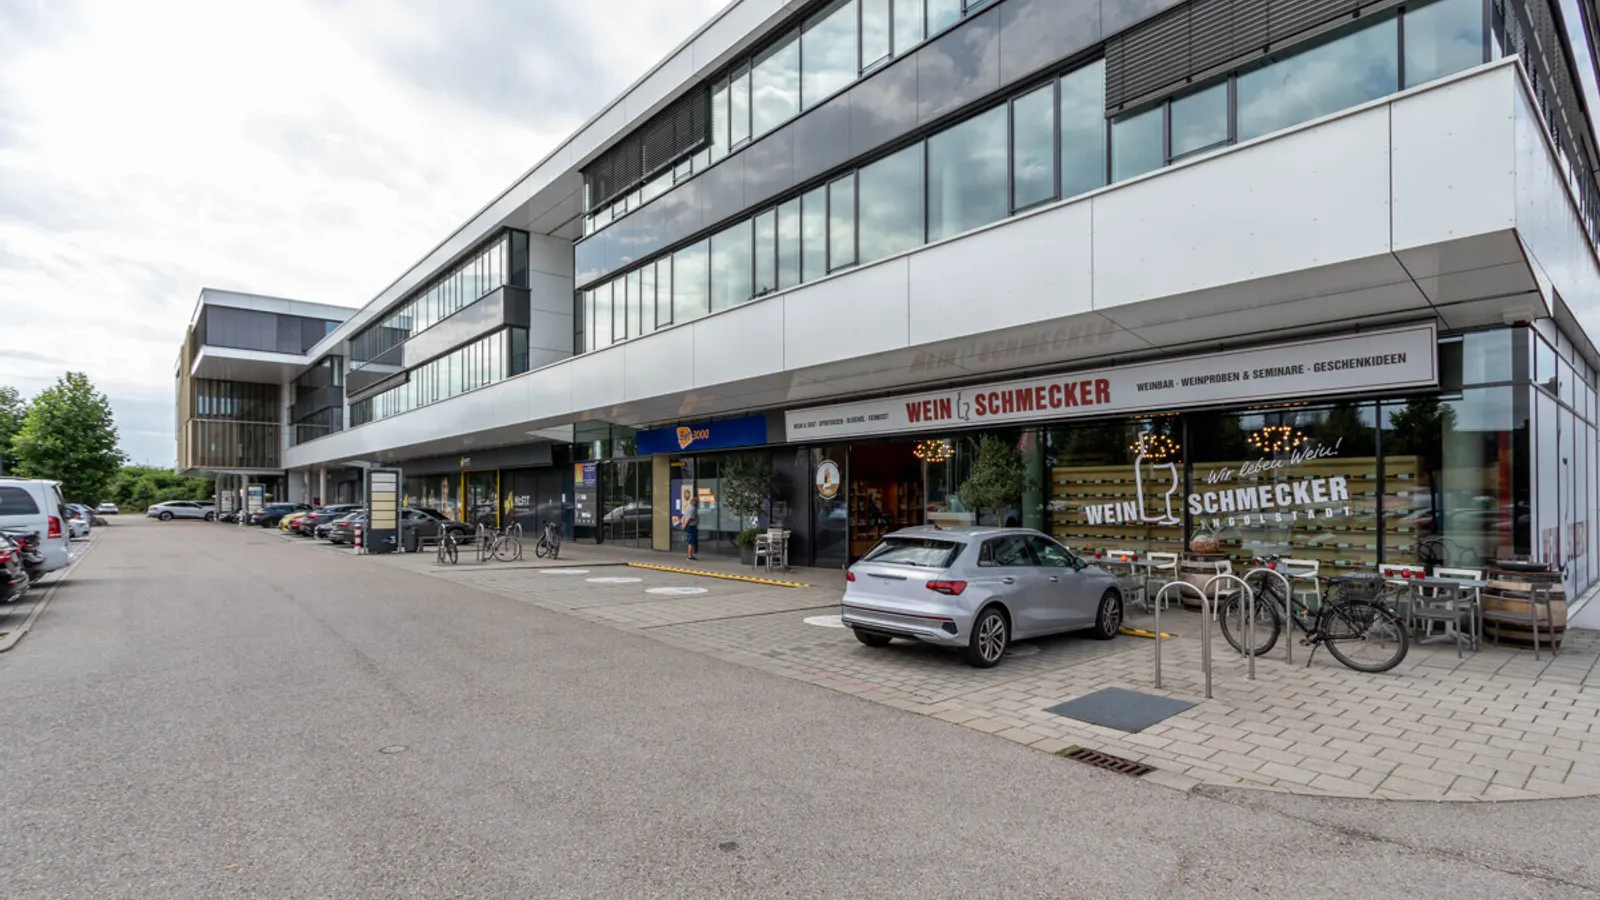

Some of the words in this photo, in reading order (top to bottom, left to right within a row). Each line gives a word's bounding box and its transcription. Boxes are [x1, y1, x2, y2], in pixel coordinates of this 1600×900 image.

[1137, 379, 1174, 392] WEINBAR
[1181, 371, 1240, 387] WEINPROBEN
[1243, 370, 1249, 380] &
[1252, 364, 1304, 379] SEMINARE
[1313, 352, 1407, 373] GESCHENKIDEEN
[905, 397, 952, 423] WEIN
[974, 378, 1111, 416] SCHMECKER
[1207, 467, 1232, 484] Wir
[1239, 459, 1284, 478] leben
[1290, 437, 1343, 465] Wein!
[1085, 501, 1137, 525] WEIN
[1188, 476, 1349, 515] SCHMECKER
